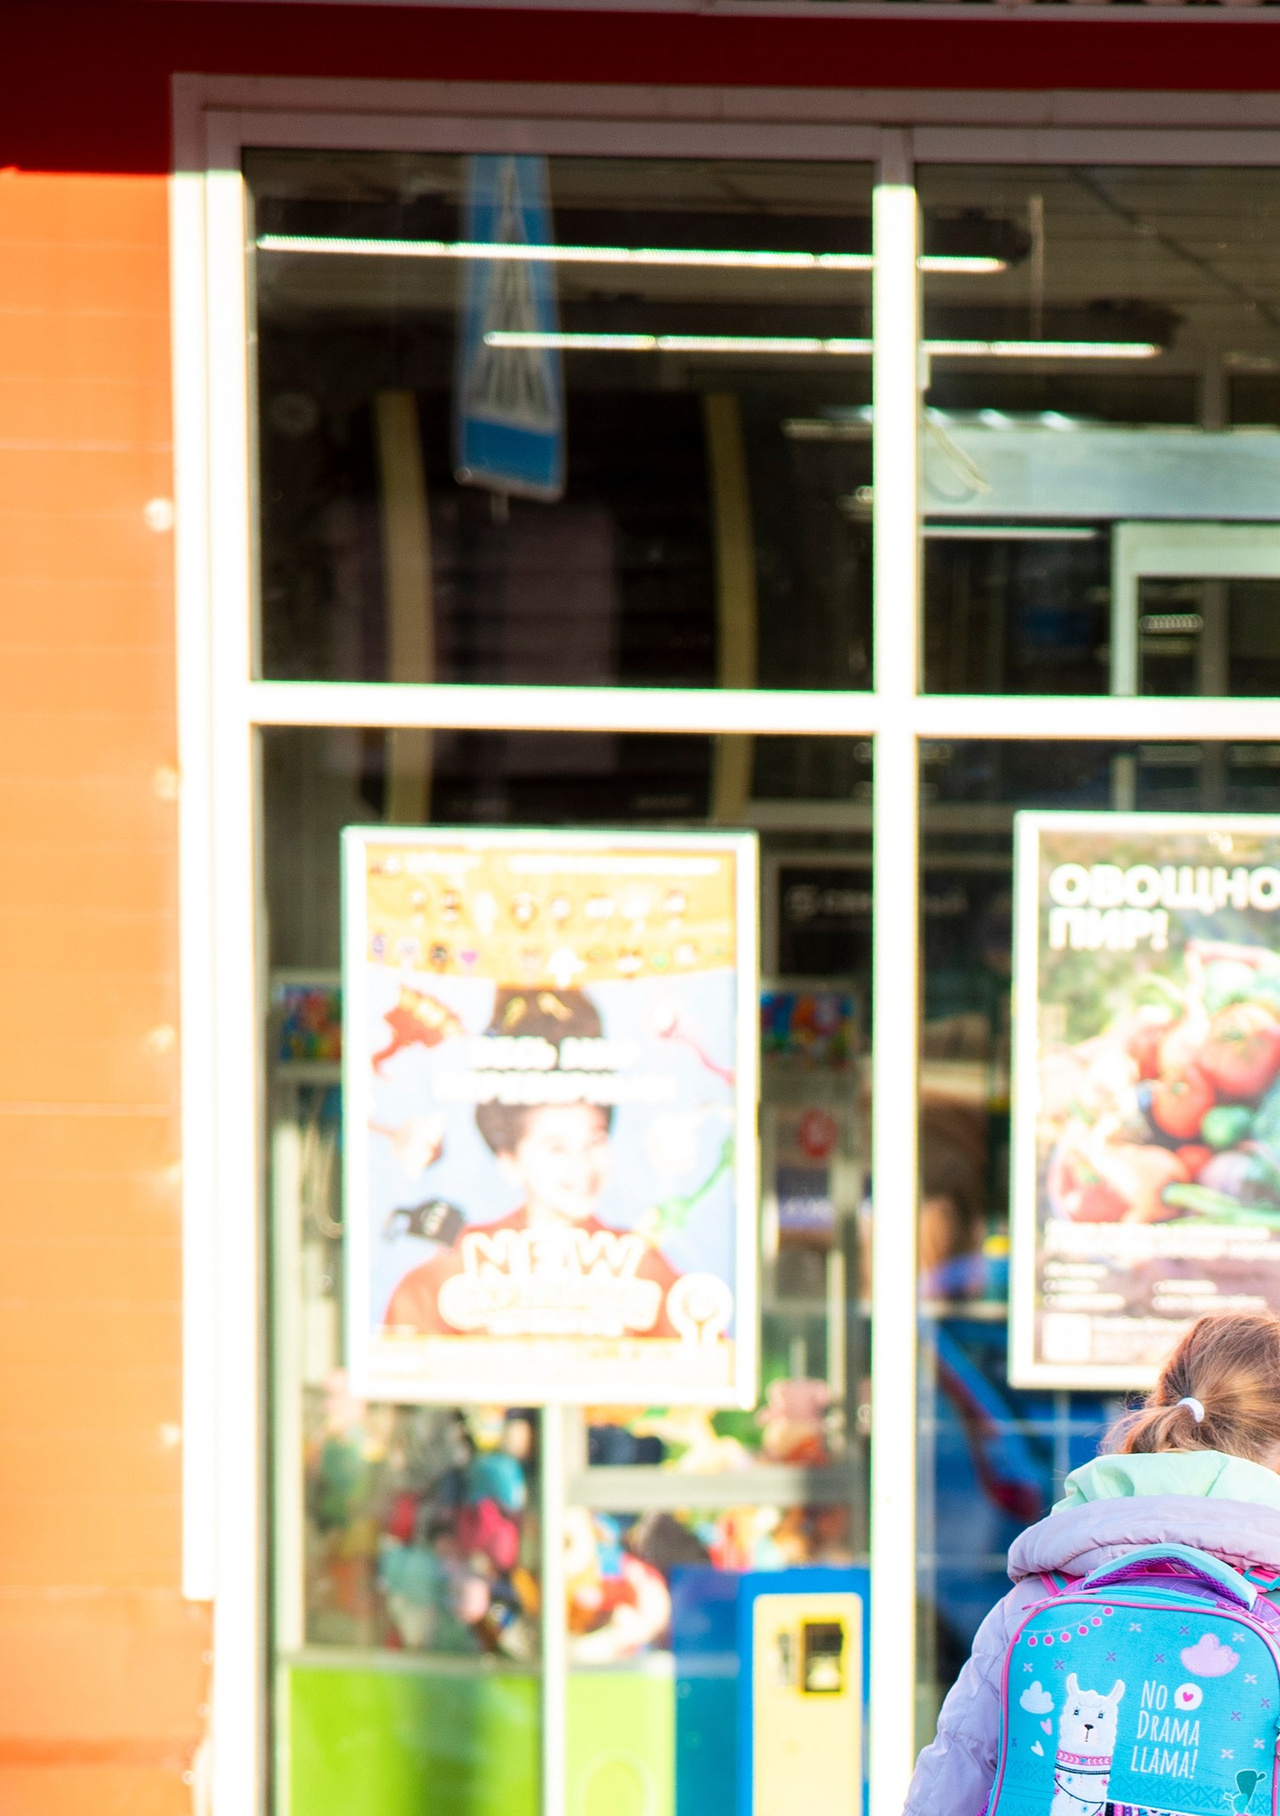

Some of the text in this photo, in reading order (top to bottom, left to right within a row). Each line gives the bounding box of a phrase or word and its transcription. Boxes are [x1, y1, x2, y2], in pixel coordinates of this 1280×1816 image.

[1050, 907, 1168, 951] ПИР!
[1141, 1680, 1168, 1711] NO
[1136, 1710, 1200, 1747] DRAMA
[1130, 1745, 1198, 1779] LLAMA!
